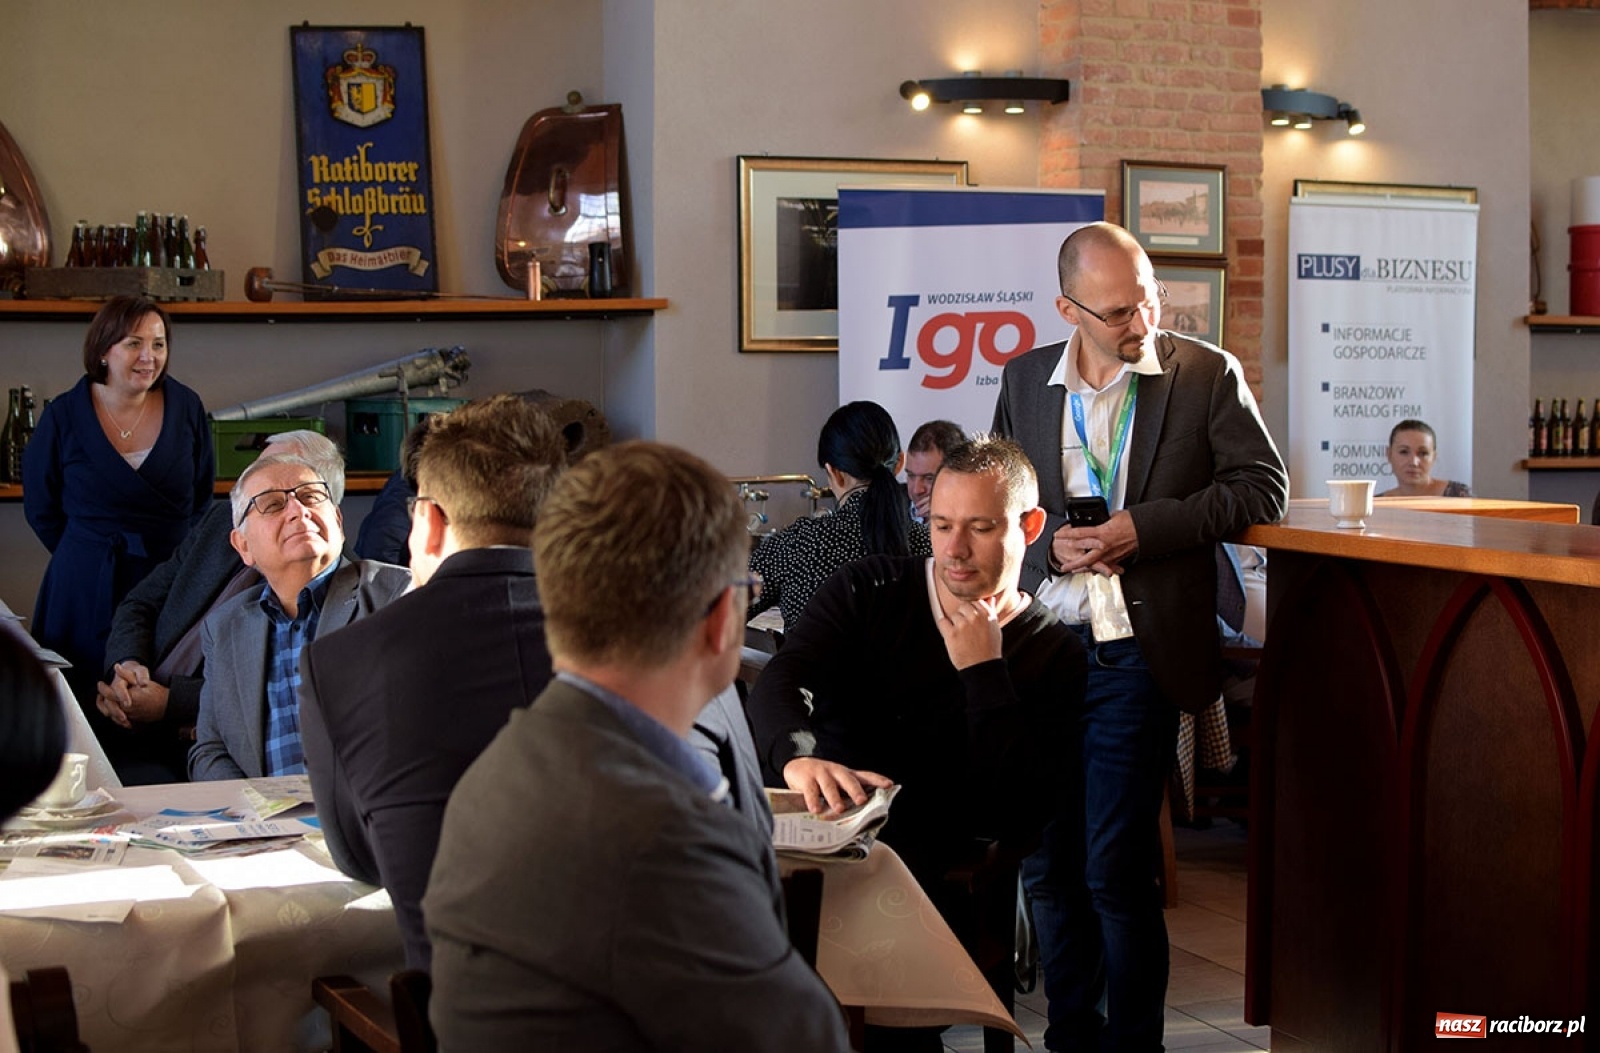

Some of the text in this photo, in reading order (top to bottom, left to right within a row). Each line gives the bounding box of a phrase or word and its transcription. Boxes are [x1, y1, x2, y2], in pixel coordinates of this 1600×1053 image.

[308, 142, 418, 183] Ratiborer
[327, 250, 412, 267] Das Heimatbier
[1300, 256, 1357, 277] PLUSY
[1377, 258, 1472, 281] BIZNESU
[928, 290, 1034, 305] WODZISŁAW ŚLĄSKI
[1334, 328, 1412, 341] INFORMACJE
[1333, 346, 1426, 360] GOSPODARCZE
[976, 374, 999, 386] Izba
[1333, 385, 1405, 400] BRANŻOWY
[1333, 404, 1421, 418] KATALOG FIRM
[1333, 444, 1388, 458] KOMUNI
